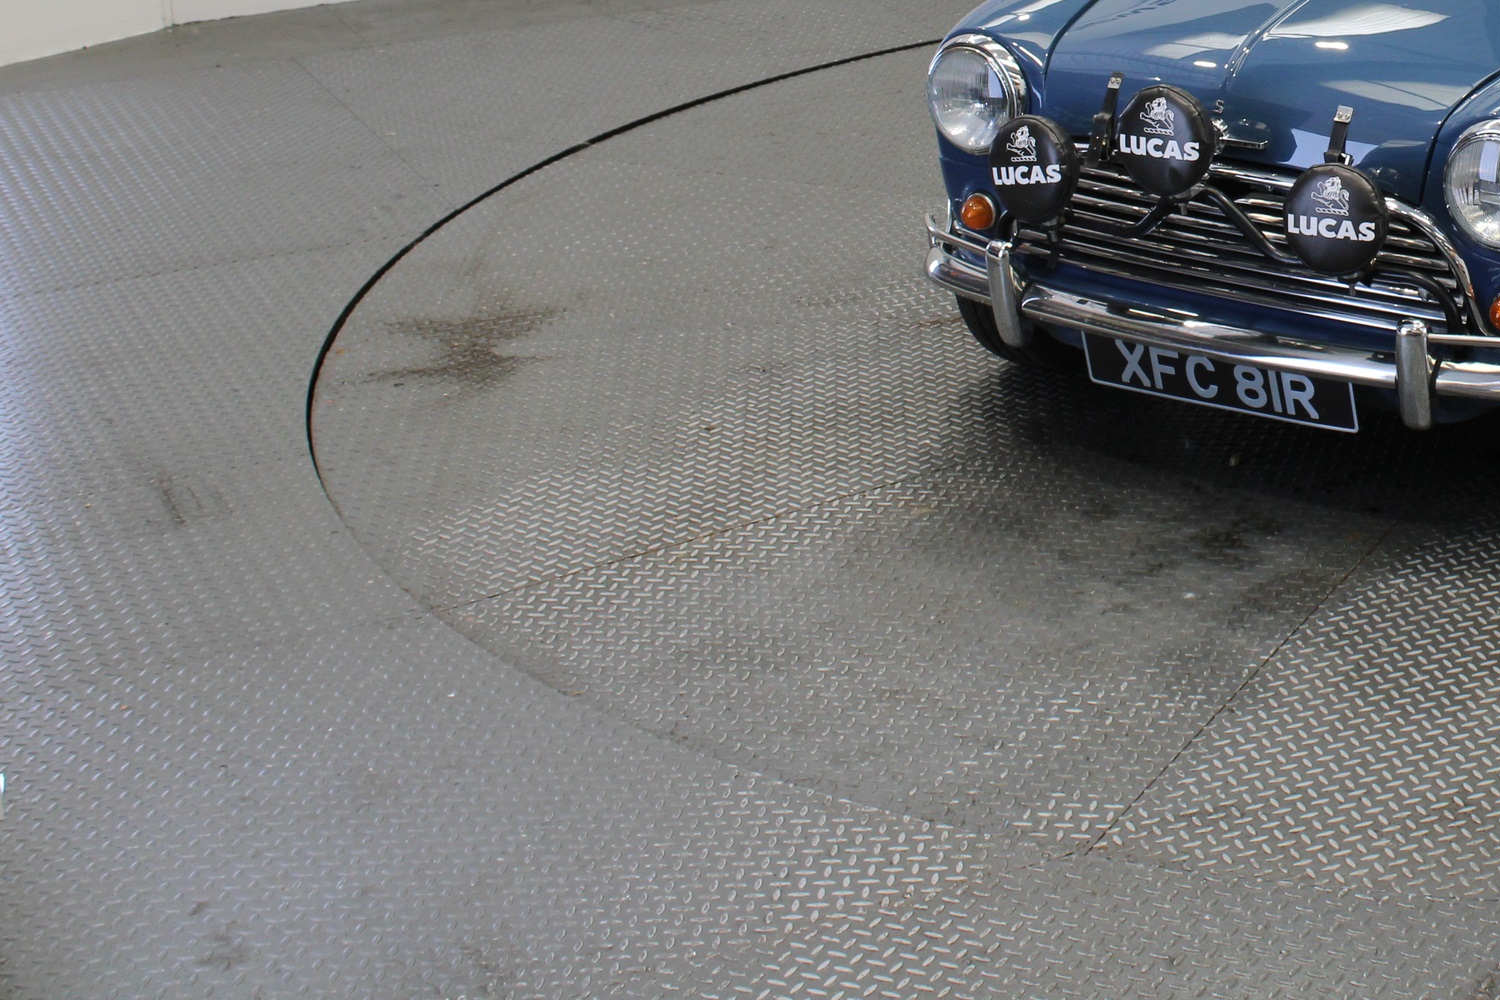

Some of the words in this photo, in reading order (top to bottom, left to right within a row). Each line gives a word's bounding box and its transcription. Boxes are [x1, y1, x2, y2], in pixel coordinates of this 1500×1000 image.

[1119, 133, 1200, 161] LUCAS
[992, 163, 1062, 186] LUCAS
[1287, 213, 1376, 242] LUCAS
[1115, 338, 1219, 399] XFC
[1233, 363, 1320, 420] 81R
